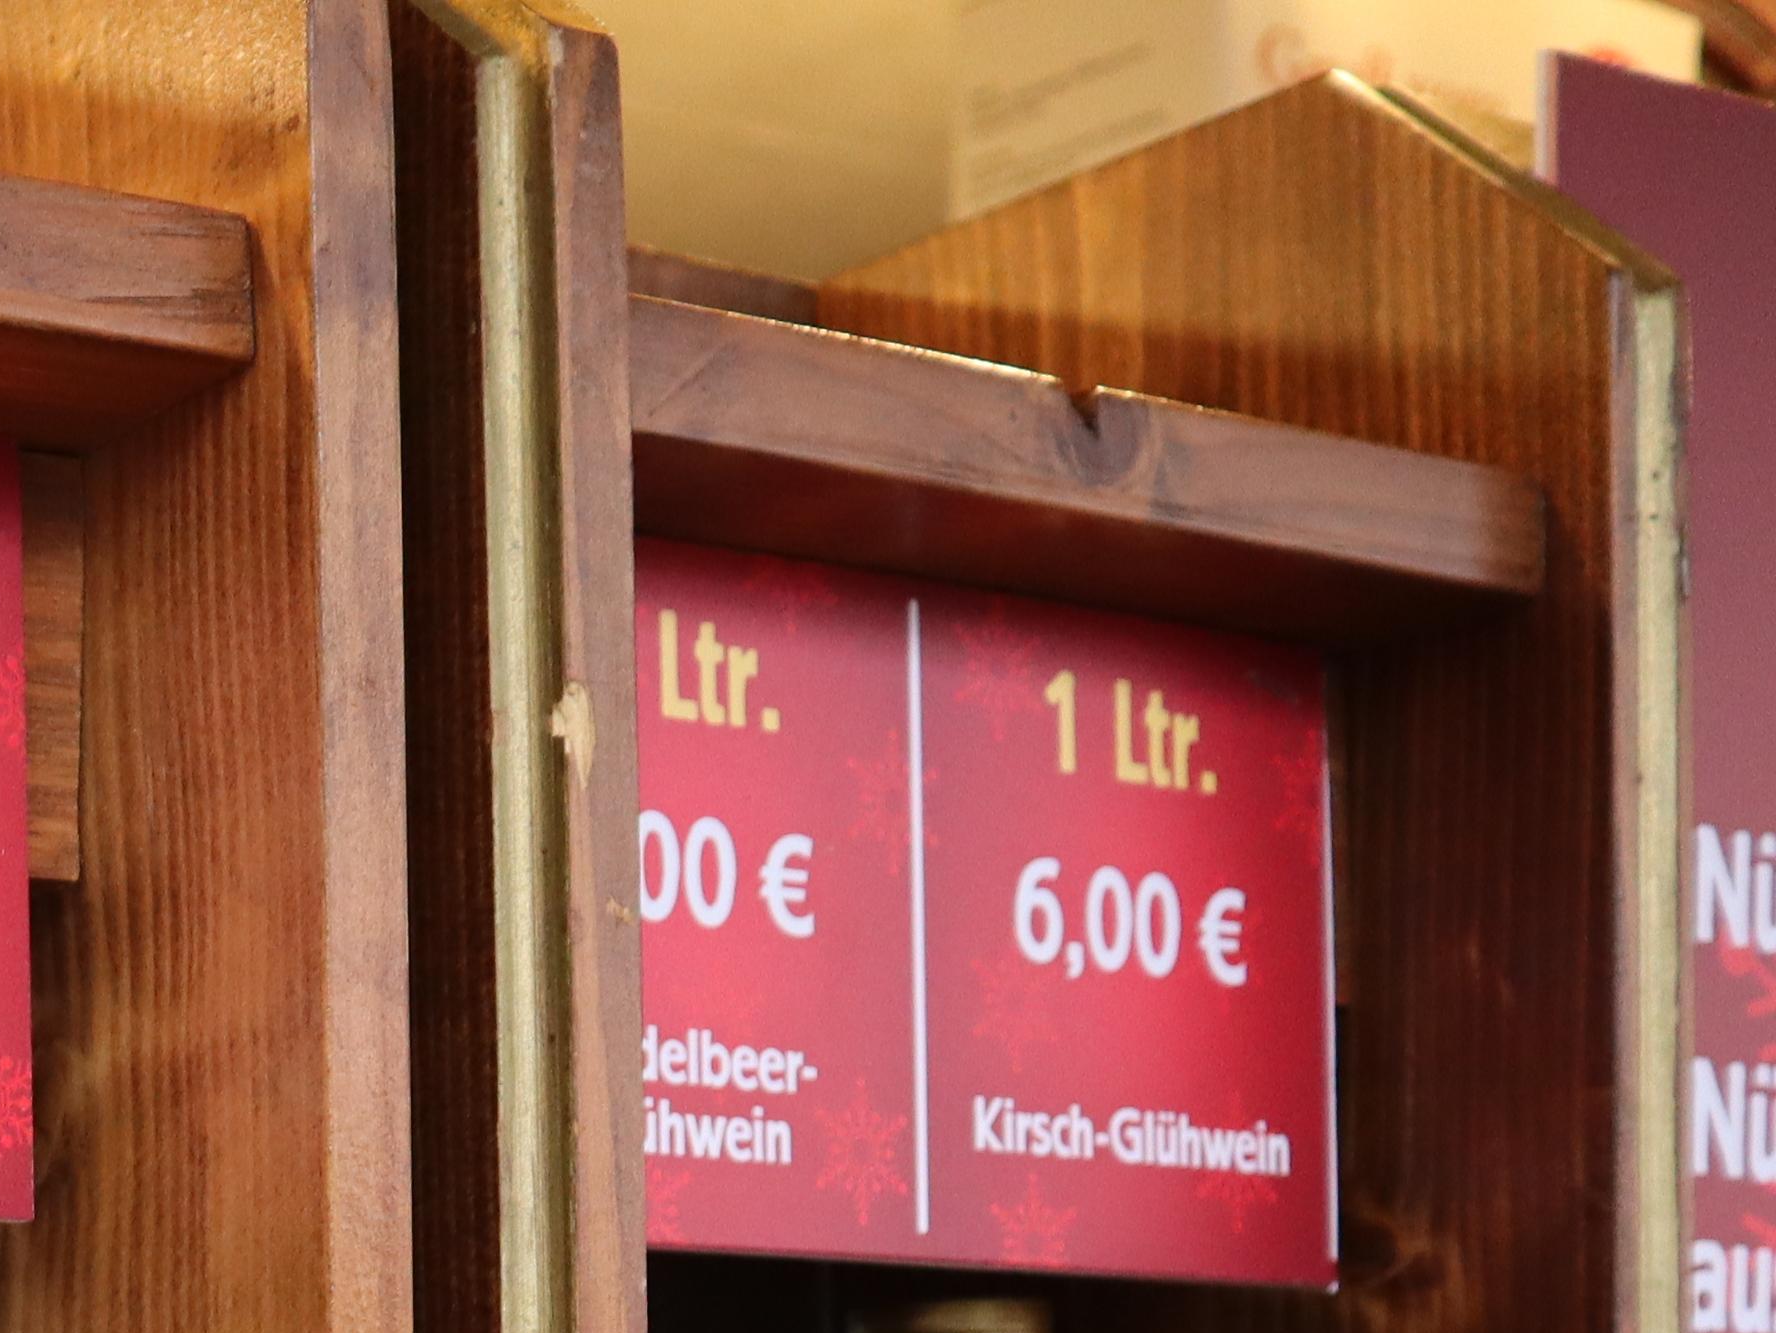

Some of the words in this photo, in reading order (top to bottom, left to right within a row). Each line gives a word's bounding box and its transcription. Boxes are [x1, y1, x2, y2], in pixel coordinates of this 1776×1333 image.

[659, 609, 780, 732] Ltr.
[1044, 670, 1077, 775] 1
[1114, 679, 1217, 794] Ltr.
[759, 834, 815, 937] €
[1013, 857, 1181, 981] 6,00
[1199, 888, 1248, 986] €
[973, 1096, 1290, 1176] Kirsch-Glühwein
